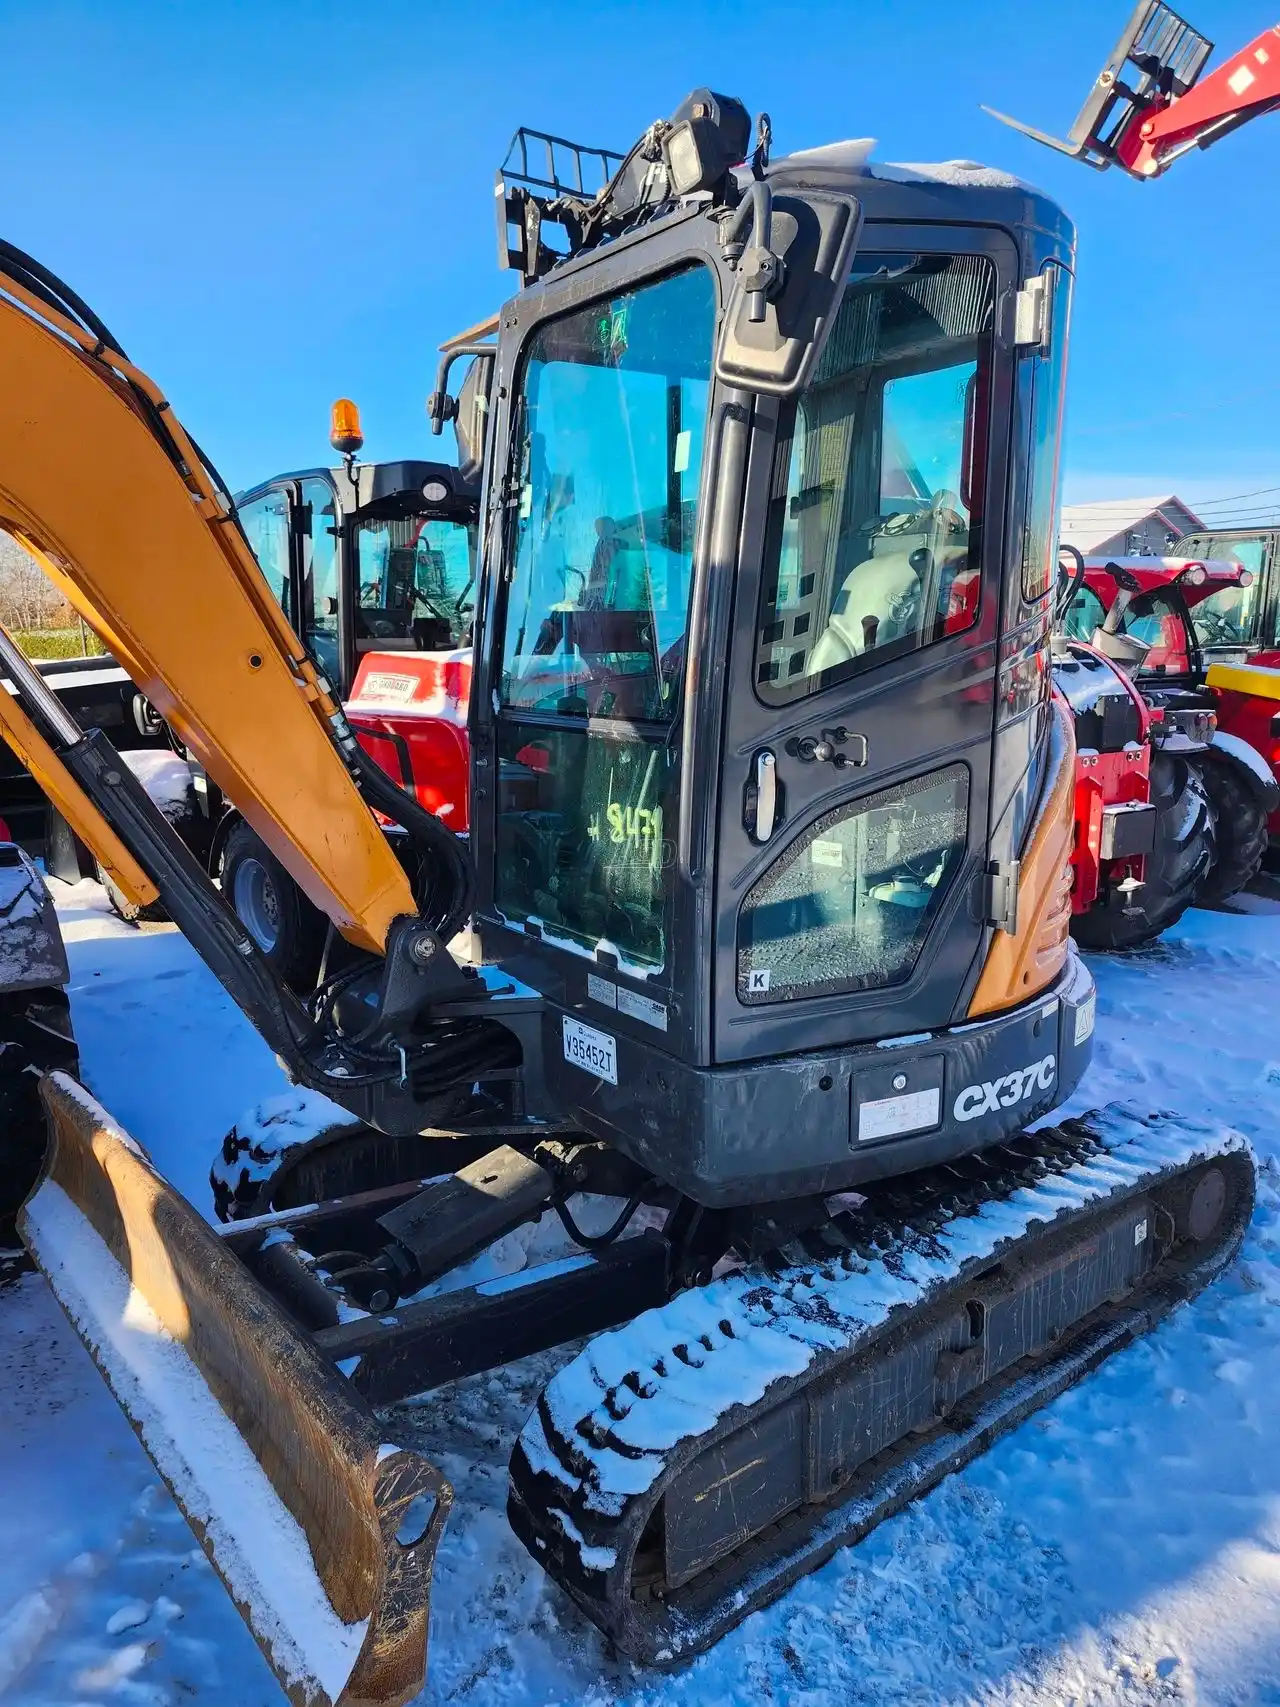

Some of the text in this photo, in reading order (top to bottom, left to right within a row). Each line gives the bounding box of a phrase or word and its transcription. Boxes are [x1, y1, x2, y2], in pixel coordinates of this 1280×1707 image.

[753, 973, 764, 988] K
[566, 1033, 612, 1073] V35452T
[953, 1054, 1056, 1122] CX37C
